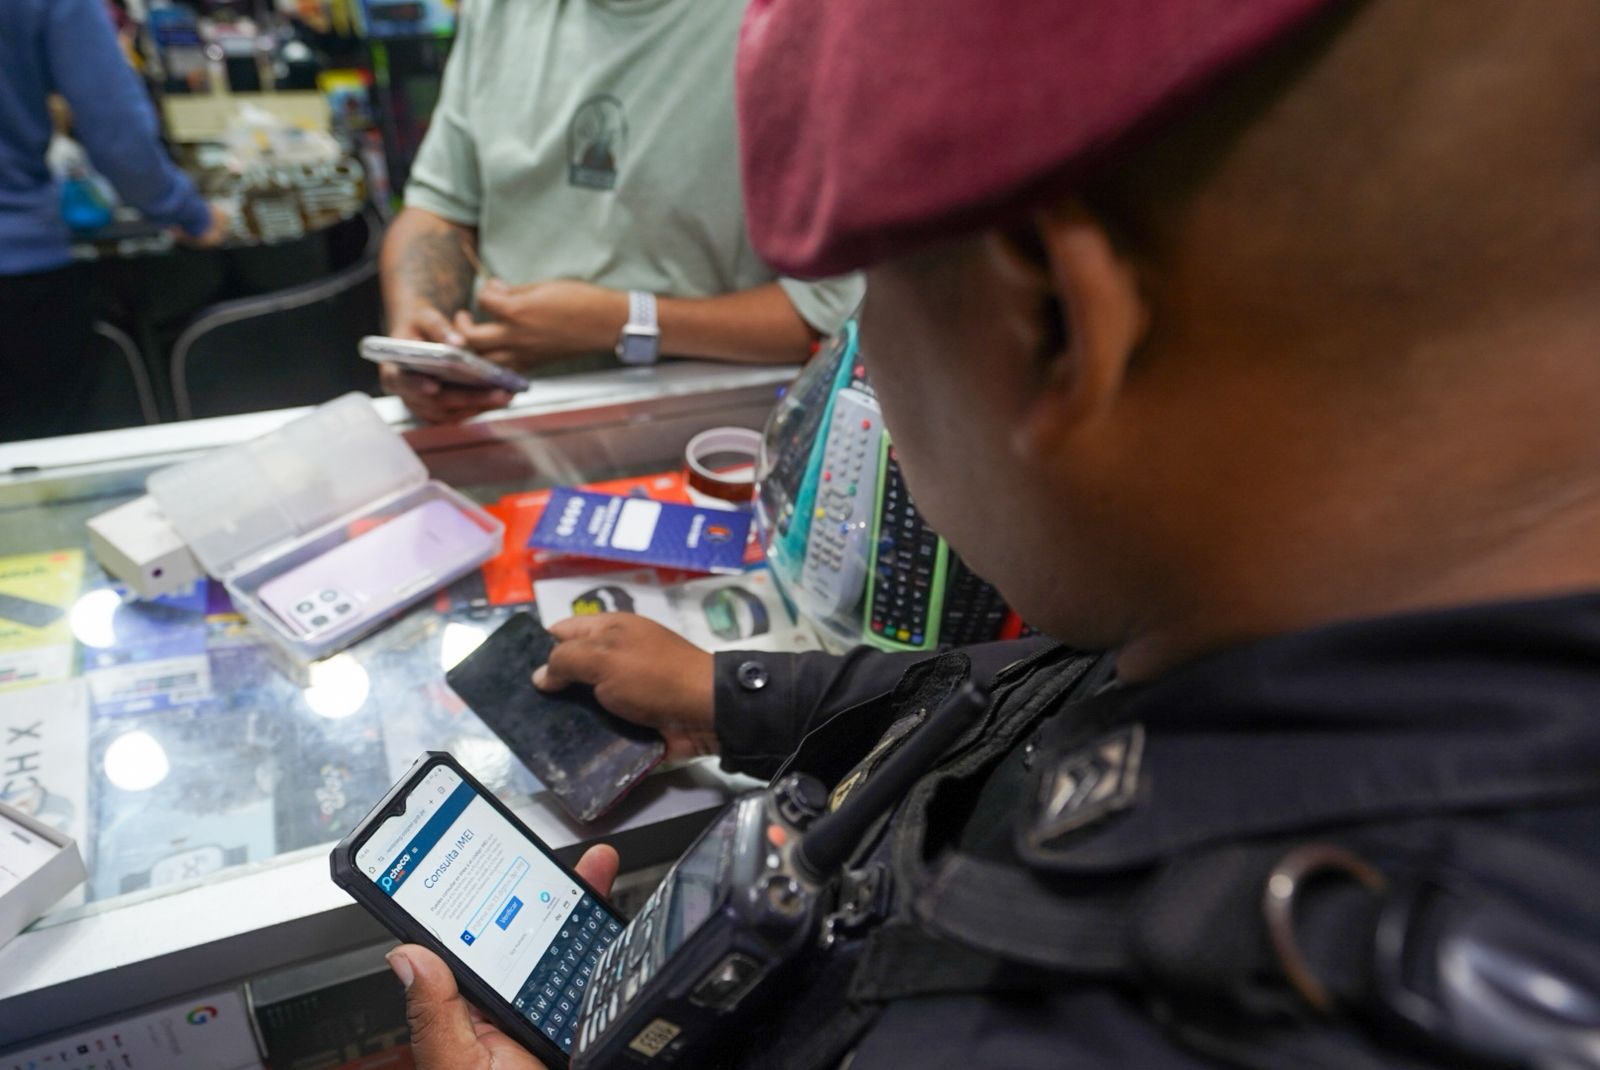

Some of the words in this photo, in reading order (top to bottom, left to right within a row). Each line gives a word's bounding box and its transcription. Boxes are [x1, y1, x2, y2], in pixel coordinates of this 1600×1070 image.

[424, 846, 459, 889] Consulta
[455, 828, 474, 850] IMEI
[499, 900, 518, 924] Verificar
[529, 1010, 539, 1021] Q
[537, 997, 547, 1010] W
[545, 987, 554, 997] E
[552, 975, 562, 985] R
[560, 963, 569, 973] T
[567, 952, 576, 962] Y
[574, 942, 583, 951] U
[588, 920, 597, 930] O
[595, 909, 603, 919] P
[545, 1024, 555, 1035] A
[553, 1012, 562, 1023] S
[560, 1000, 570, 1010] D
[568, 989, 576, 998] F
[575, 977, 584, 987] G
[582, 966, 591, 976] H
[596, 944, 604, 954] K
[602, 934, 611, 943] L
